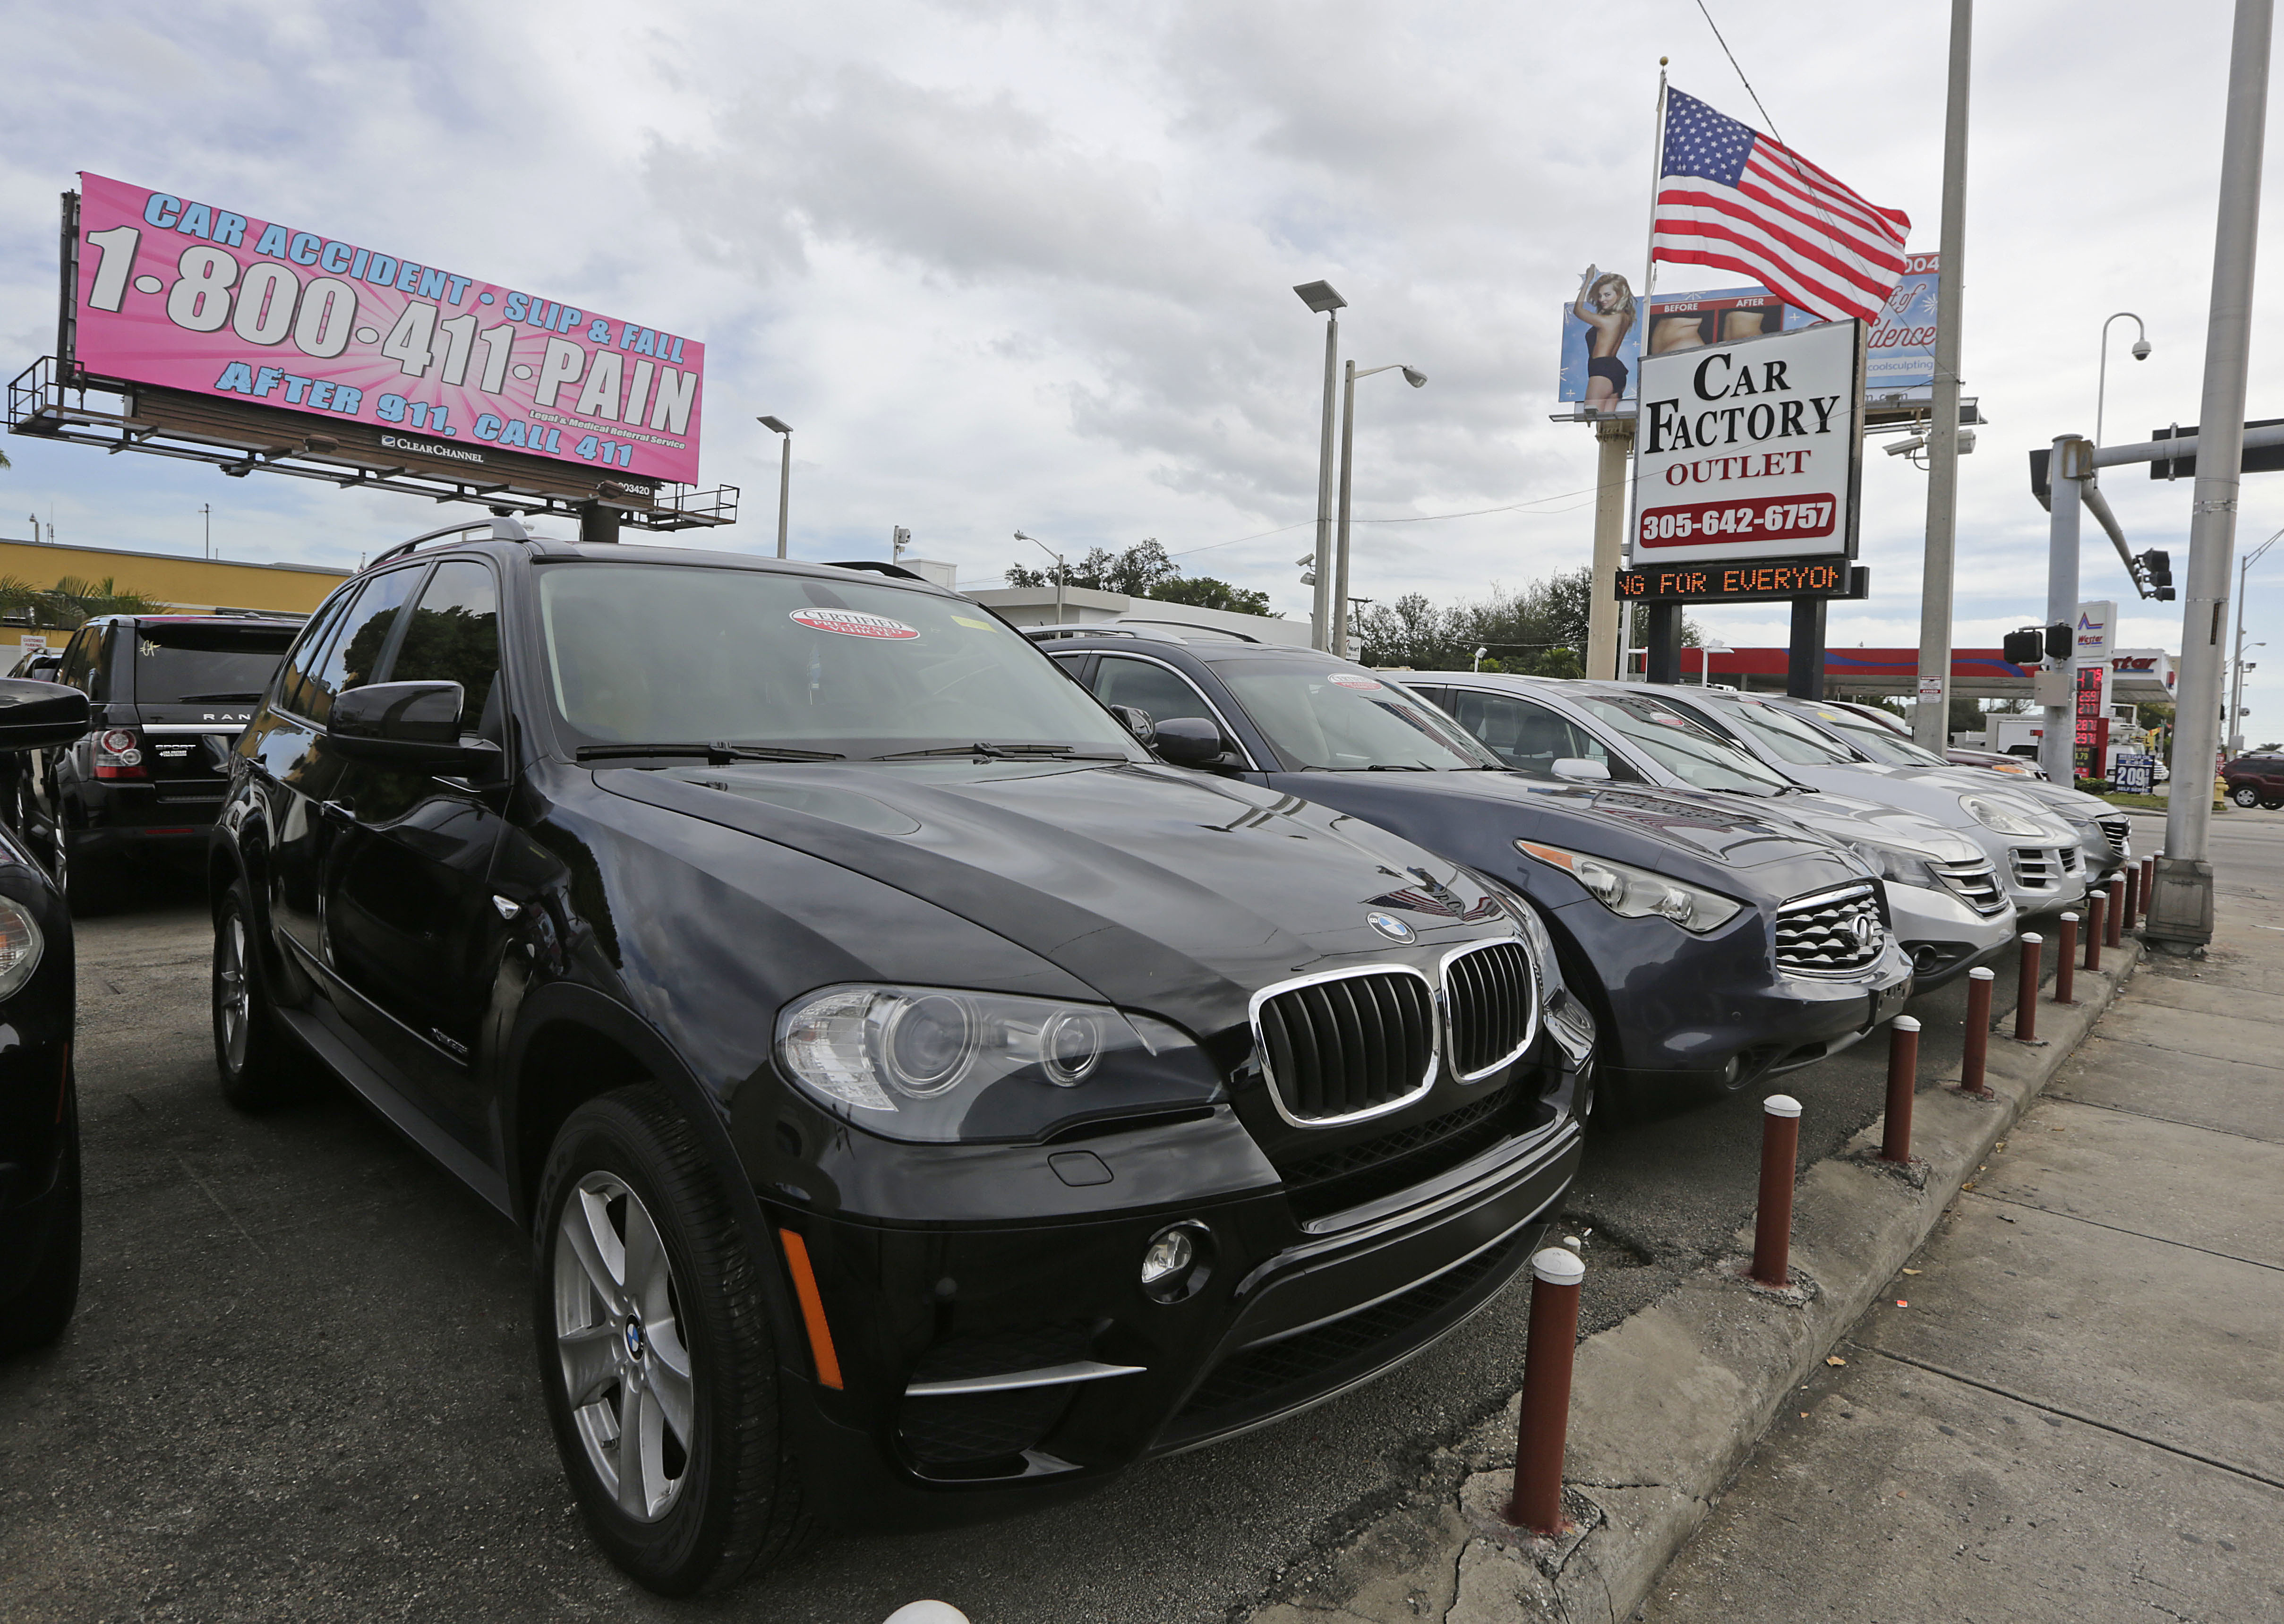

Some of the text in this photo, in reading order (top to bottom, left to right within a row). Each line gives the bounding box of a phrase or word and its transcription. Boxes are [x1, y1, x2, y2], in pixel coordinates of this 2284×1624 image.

[143, 193, 684, 364] CAR ACCIDENT SLIP & FALL
[1664, 298, 1764, 313] BEFORE AFTER
[1895, 283, 1926, 313] of
[1694, 353, 1791, 401] CAR
[1868, 360, 1933, 372] coolsculpting
[214, 361, 633, 467] AFTER 911, CALL 411
[1644, 395, 1840, 454] FACTORY
[529, 410, 559, 423] Legal
[568, 418, 609, 434] Medical
[610, 427, 649, 442] Referral
[650, 436, 685, 449] Service
[1666, 450, 1811, 486] OUTLET
[1643, 502, 1832, 540] 305-642-6757
[1660, 572, 1706, 594] FOR
[804, 611, 902, 629] CERTIFIED
[813, 620, 903, 634] PRE-OWNED
[829, 626, 894, 637] VEHICLE
[2078, 635, 2103, 645] Westar
